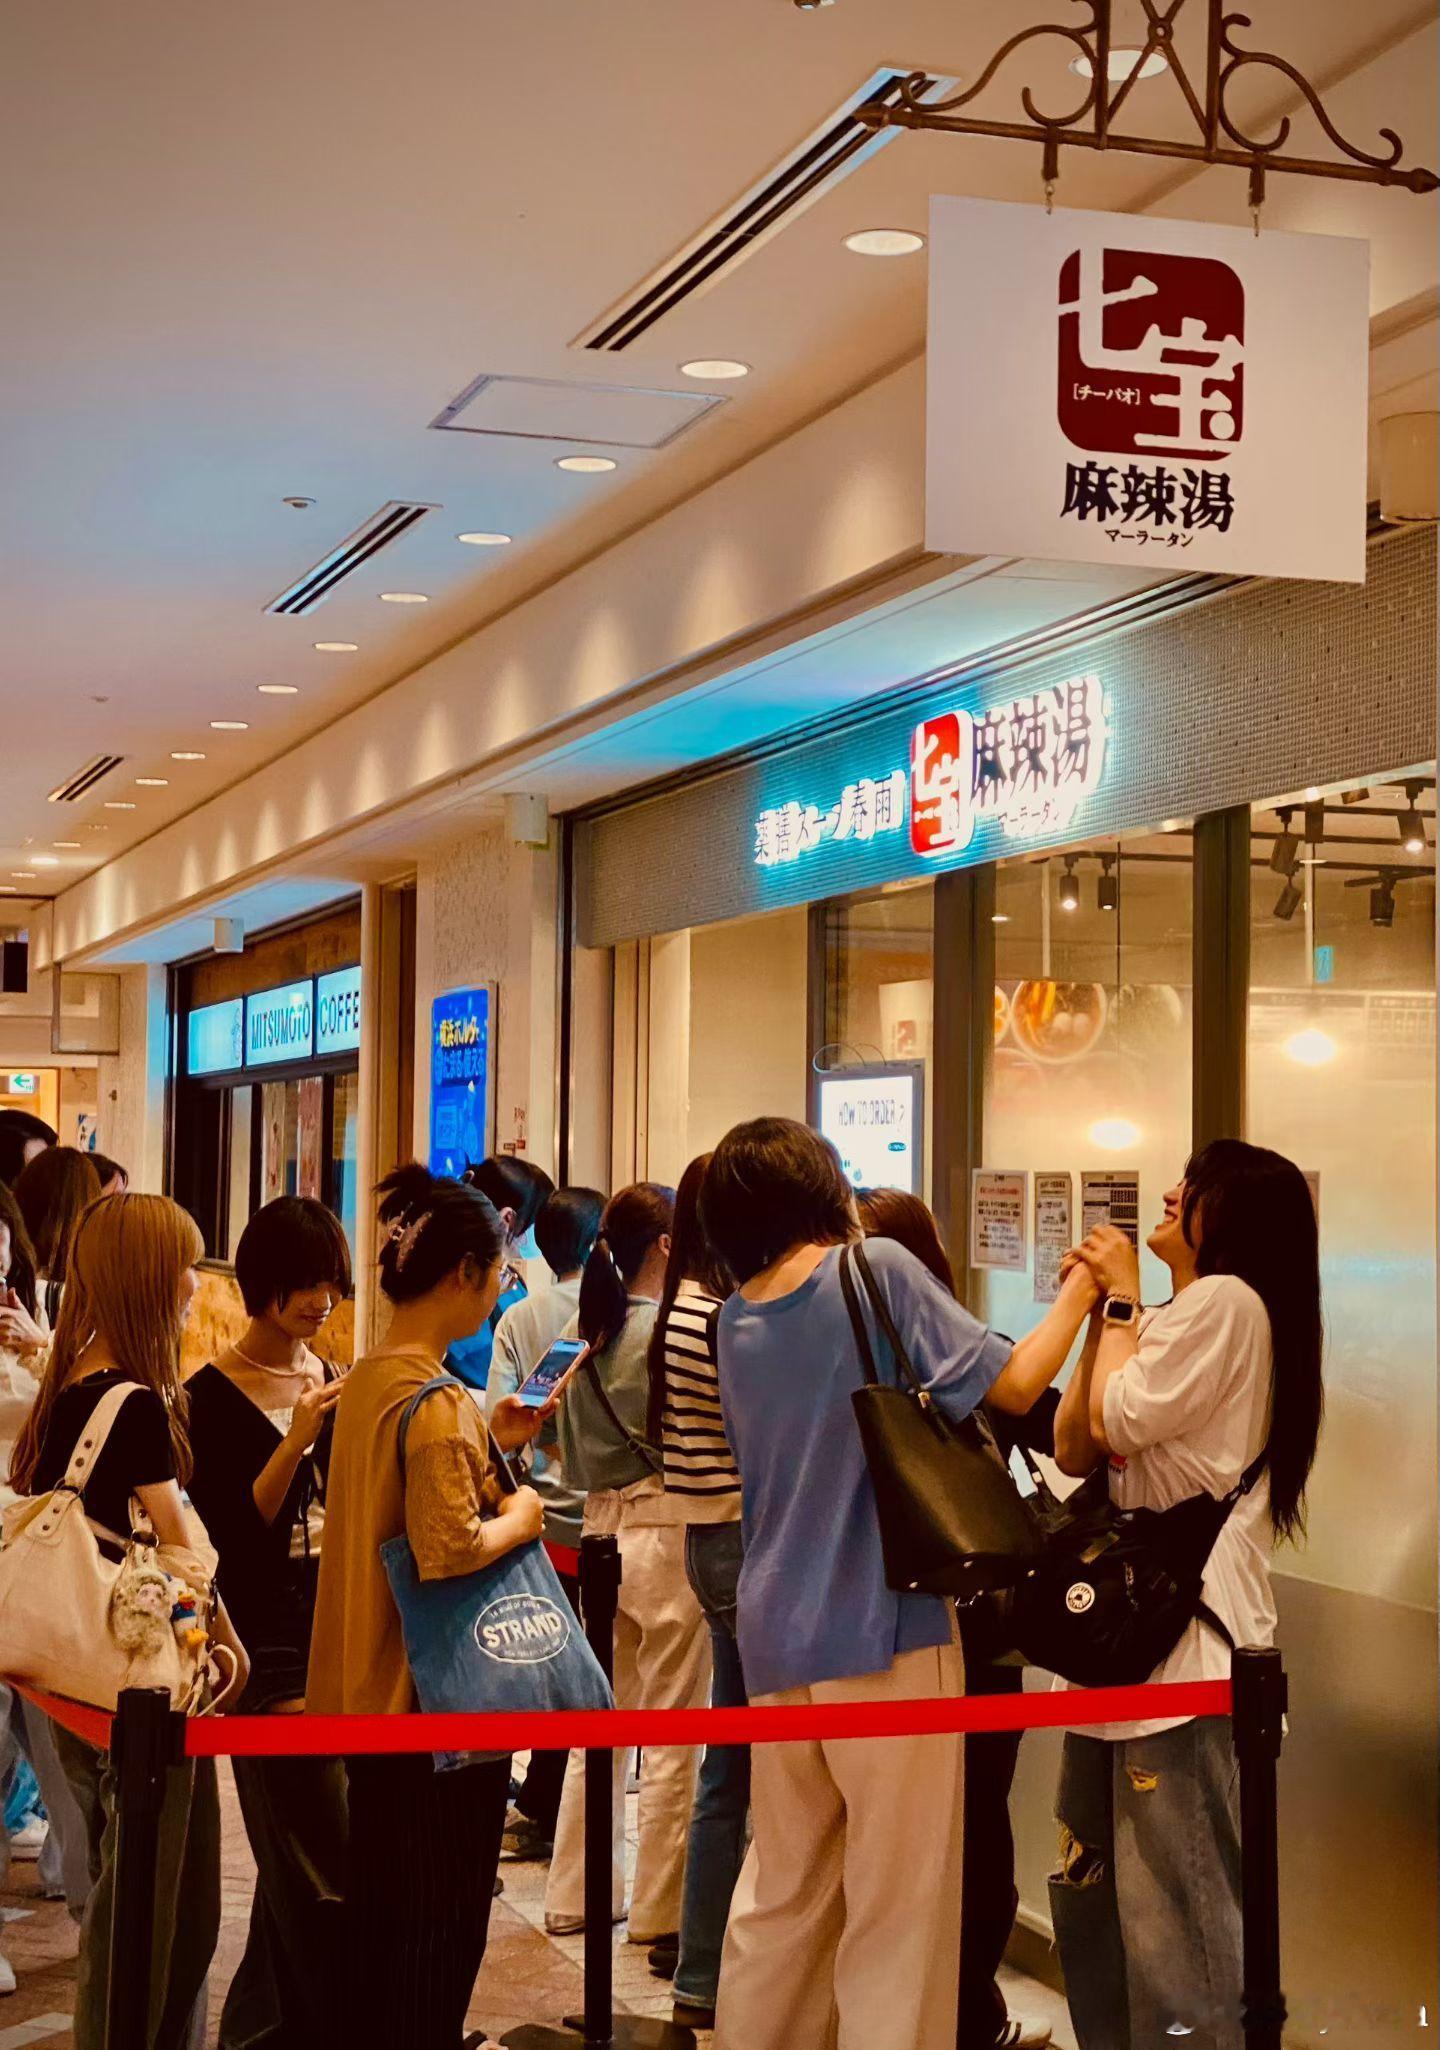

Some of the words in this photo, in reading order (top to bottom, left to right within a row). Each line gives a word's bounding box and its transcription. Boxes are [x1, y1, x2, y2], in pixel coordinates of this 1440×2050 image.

[1059, 461, 1235, 533] 麻辣湯
[1104, 529, 1195, 548] マーラータン
[971, 679, 1094, 809] 麻辣湯
[251, 1001, 311, 1050] MITSUMOTO
[838, 1101, 856, 1127] HOW
[857, 1100, 868, 1126] TO
[869, 1099, 896, 1126] ORDER
[483, 1611, 562, 1648] STRAND
